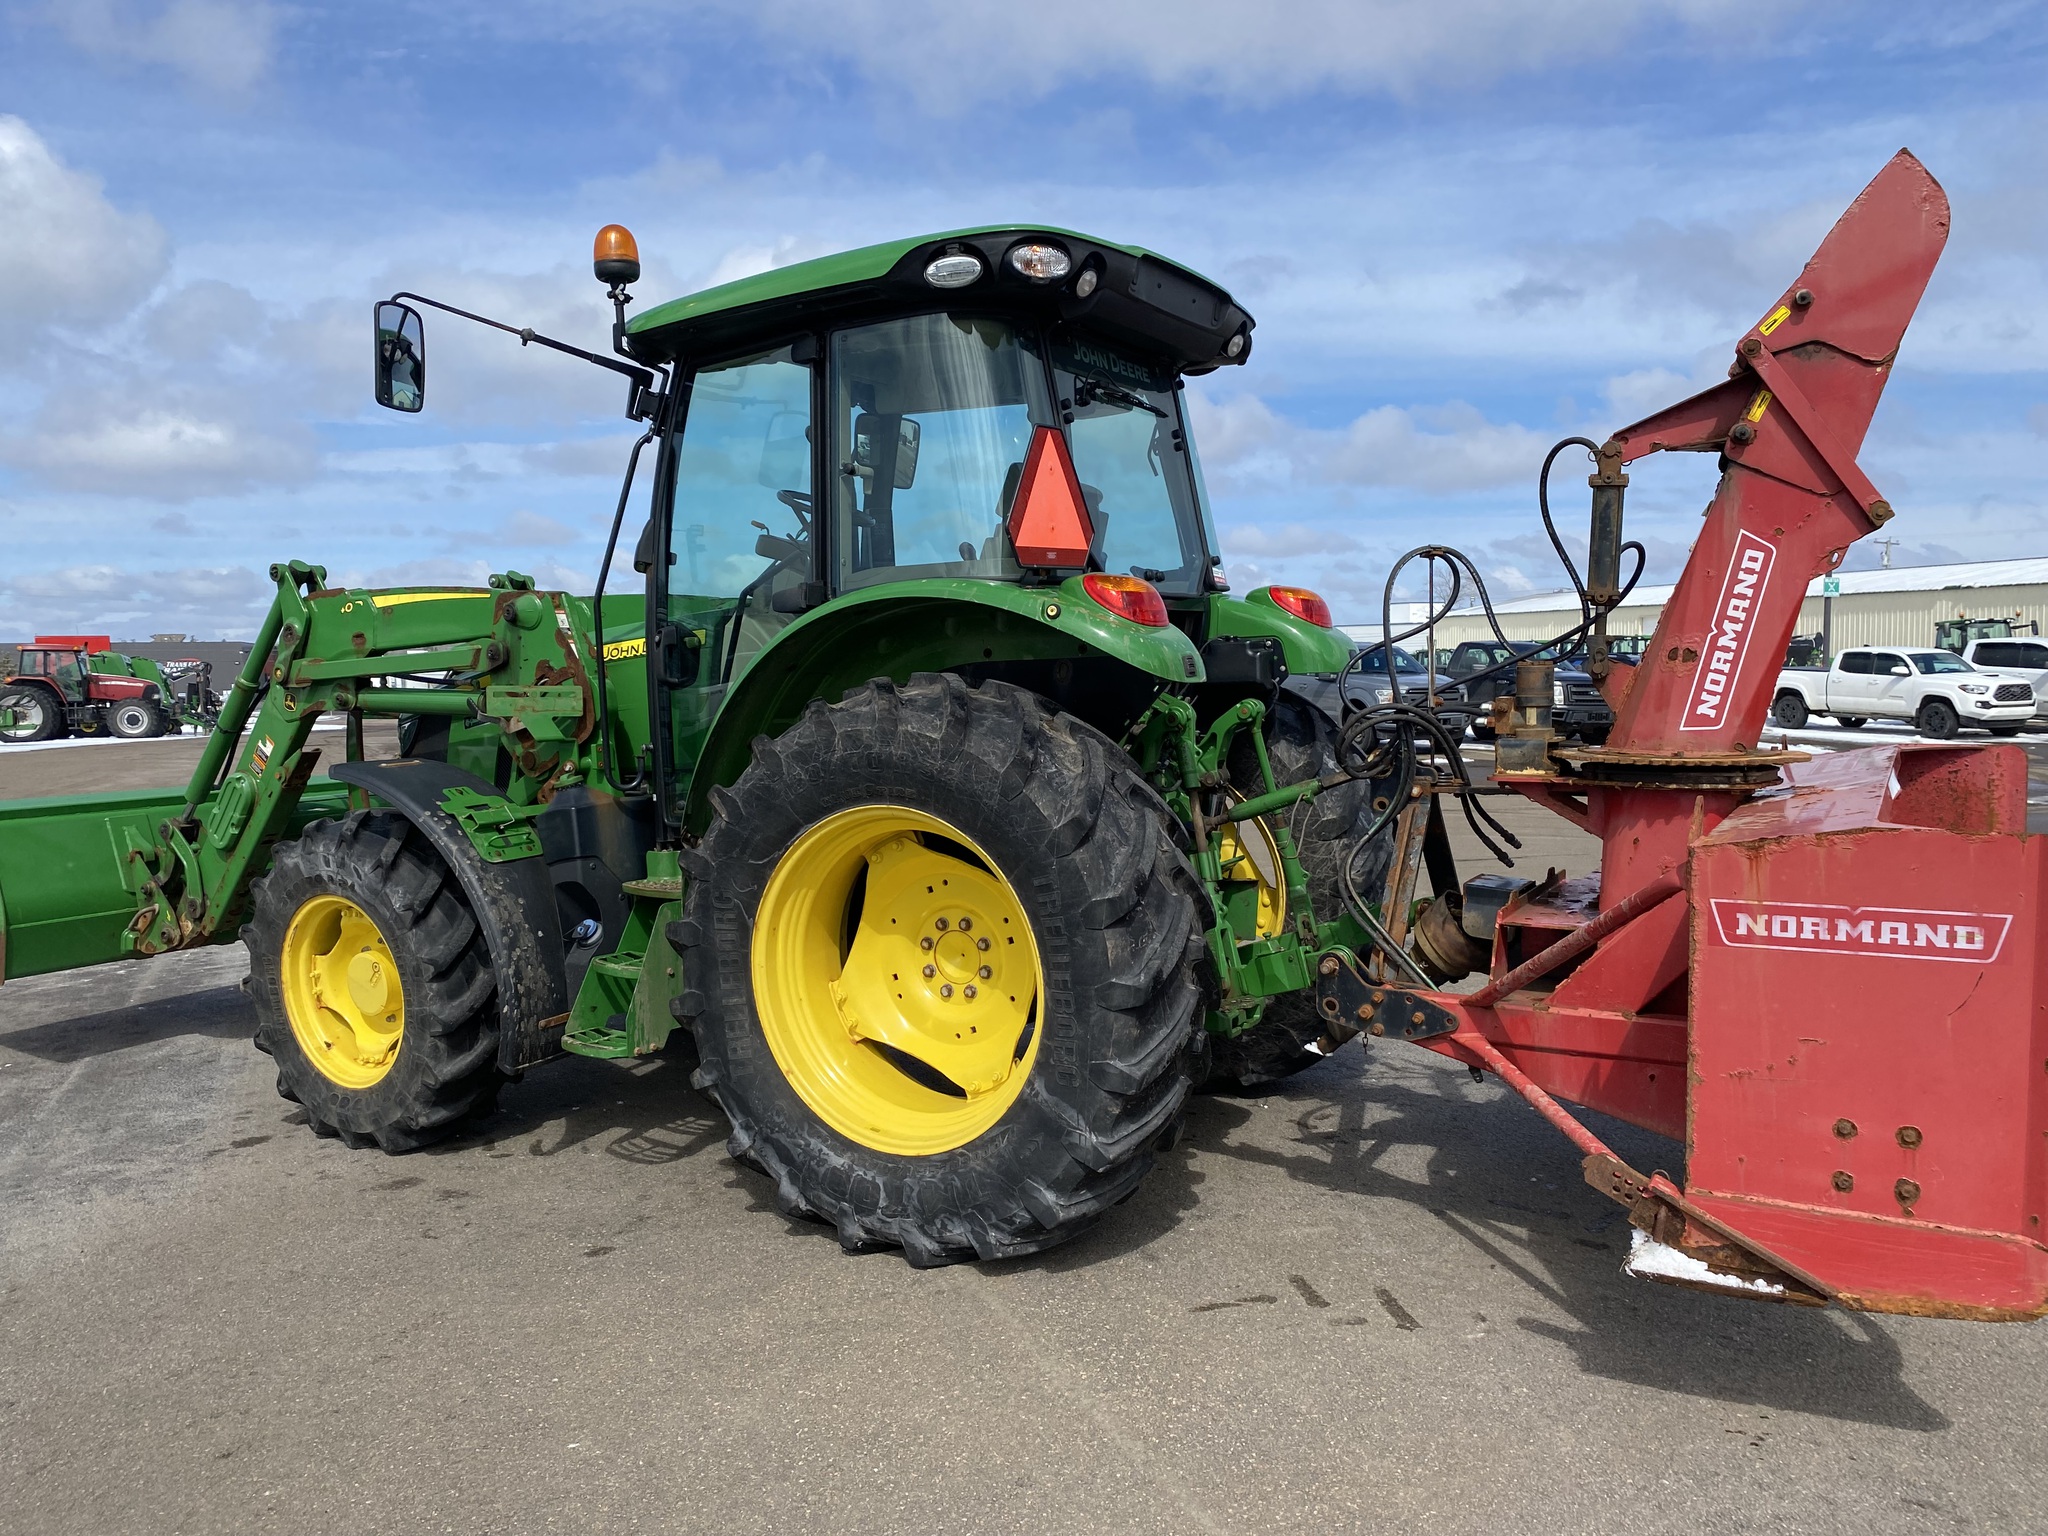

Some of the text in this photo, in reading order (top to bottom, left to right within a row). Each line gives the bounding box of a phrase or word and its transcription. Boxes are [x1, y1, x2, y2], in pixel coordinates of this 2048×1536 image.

[1074, 340, 1151, 384] JOHN DEERE
[603, 645, 640, 659] JOHN
[1696, 549, 1765, 718] NORMAND
[1736, 912, 1985, 950] NORMAND
